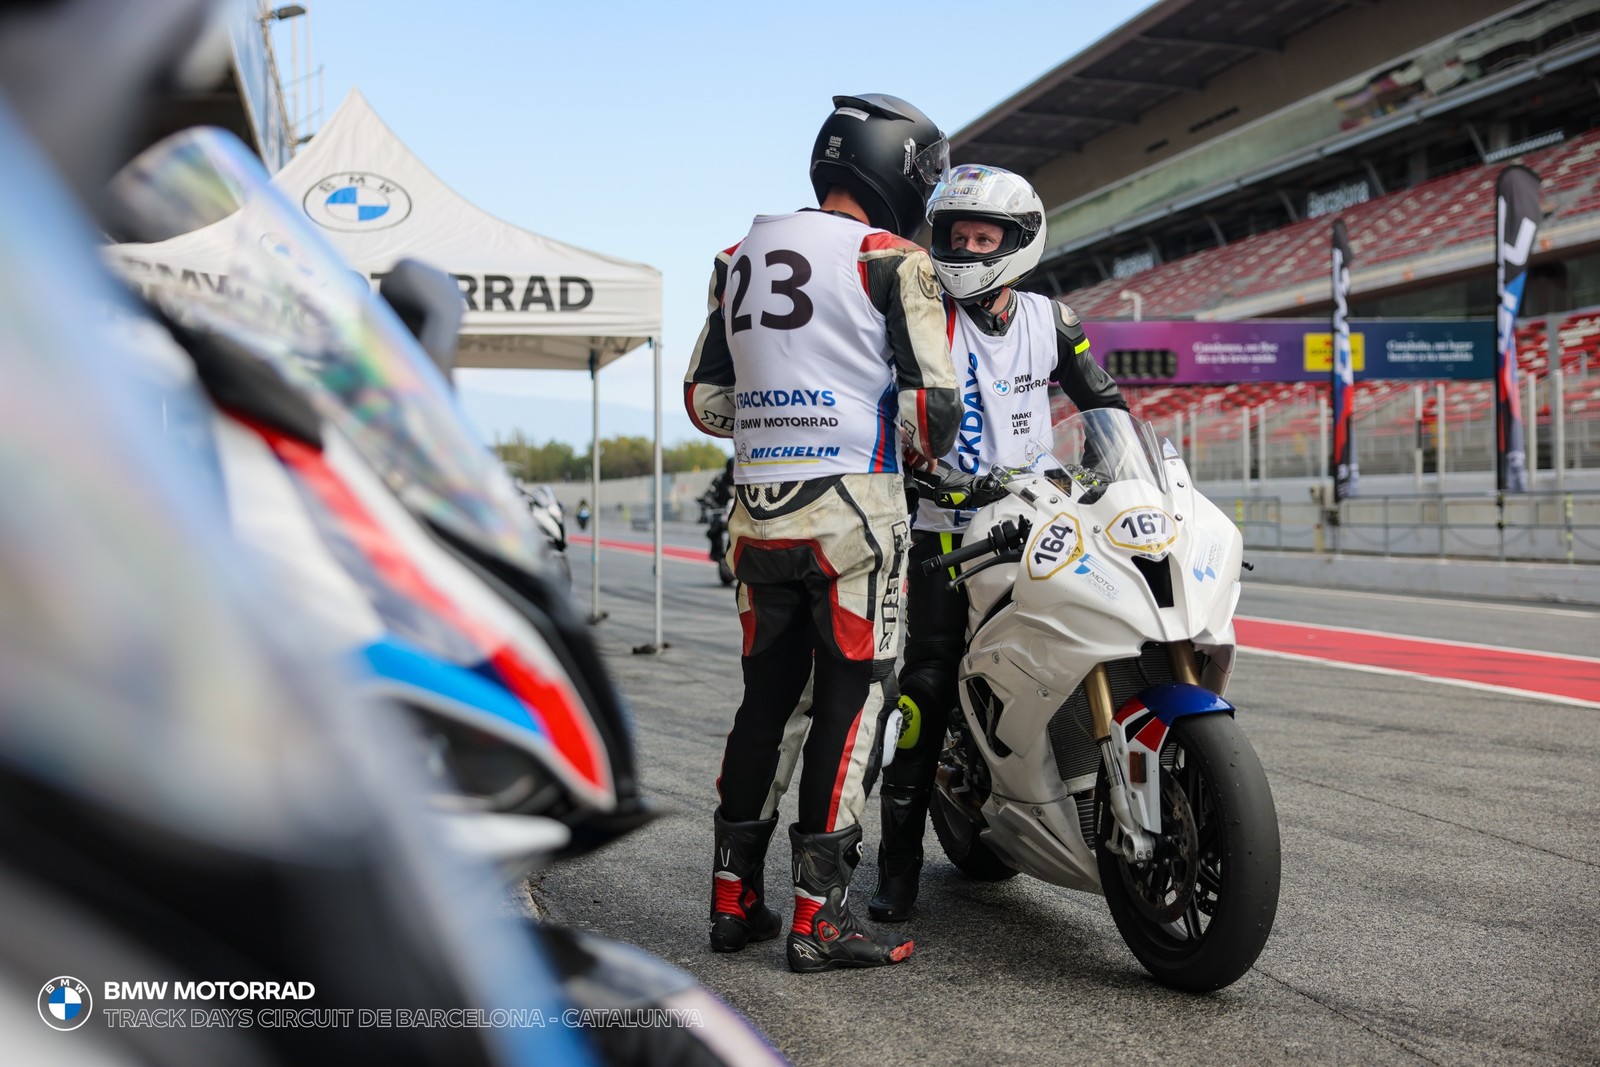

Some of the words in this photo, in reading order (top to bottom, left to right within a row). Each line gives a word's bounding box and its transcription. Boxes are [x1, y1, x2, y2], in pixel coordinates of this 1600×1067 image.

[731, 249, 813, 336] 23
[741, 418, 761, 429] BMW
[764, 417, 839, 428] MOTORRAD
[1012, 420, 1028, 428] LIFE
[751, 446, 840, 458] MICHELIN
[1120, 513, 1166, 538] 167
[1033, 525, 1073, 564] 164
[1090, 571, 1115, 592] MOTO
